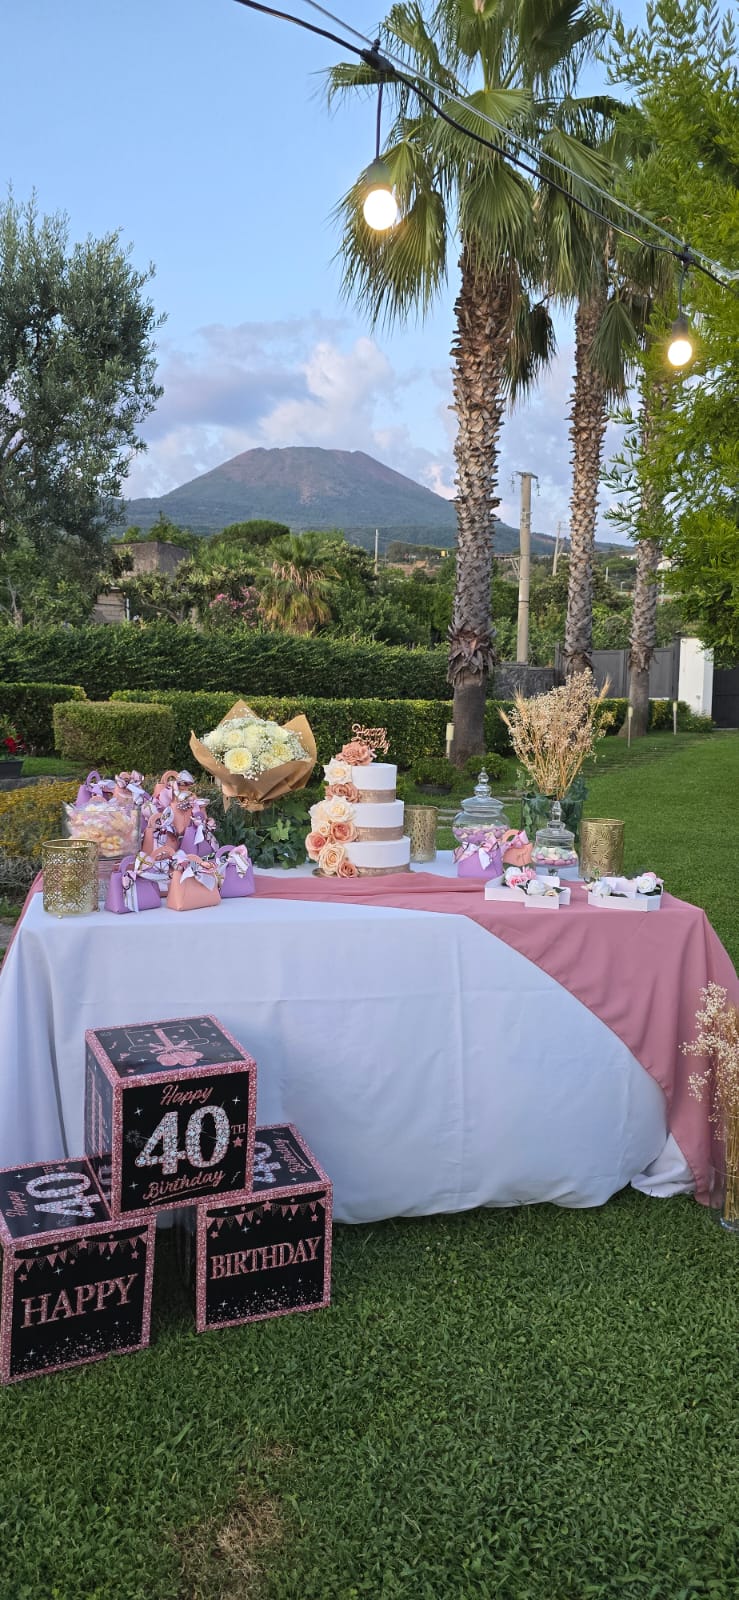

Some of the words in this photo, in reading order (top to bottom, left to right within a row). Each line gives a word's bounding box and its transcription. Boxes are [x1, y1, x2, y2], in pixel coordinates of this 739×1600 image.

[160, 1084, 214, 1105] Happy
[135, 1105, 230, 1175] 40
[231, 1123, 246, 1134] TH
[6, 1190, 28, 1218] Happy
[26, 1172, 101, 1218] 40
[142, 1170, 226, 1200] Birthday
[210, 1236, 322, 1280] BIRTHDAY
[20, 1272, 139, 1329] HAPPY
